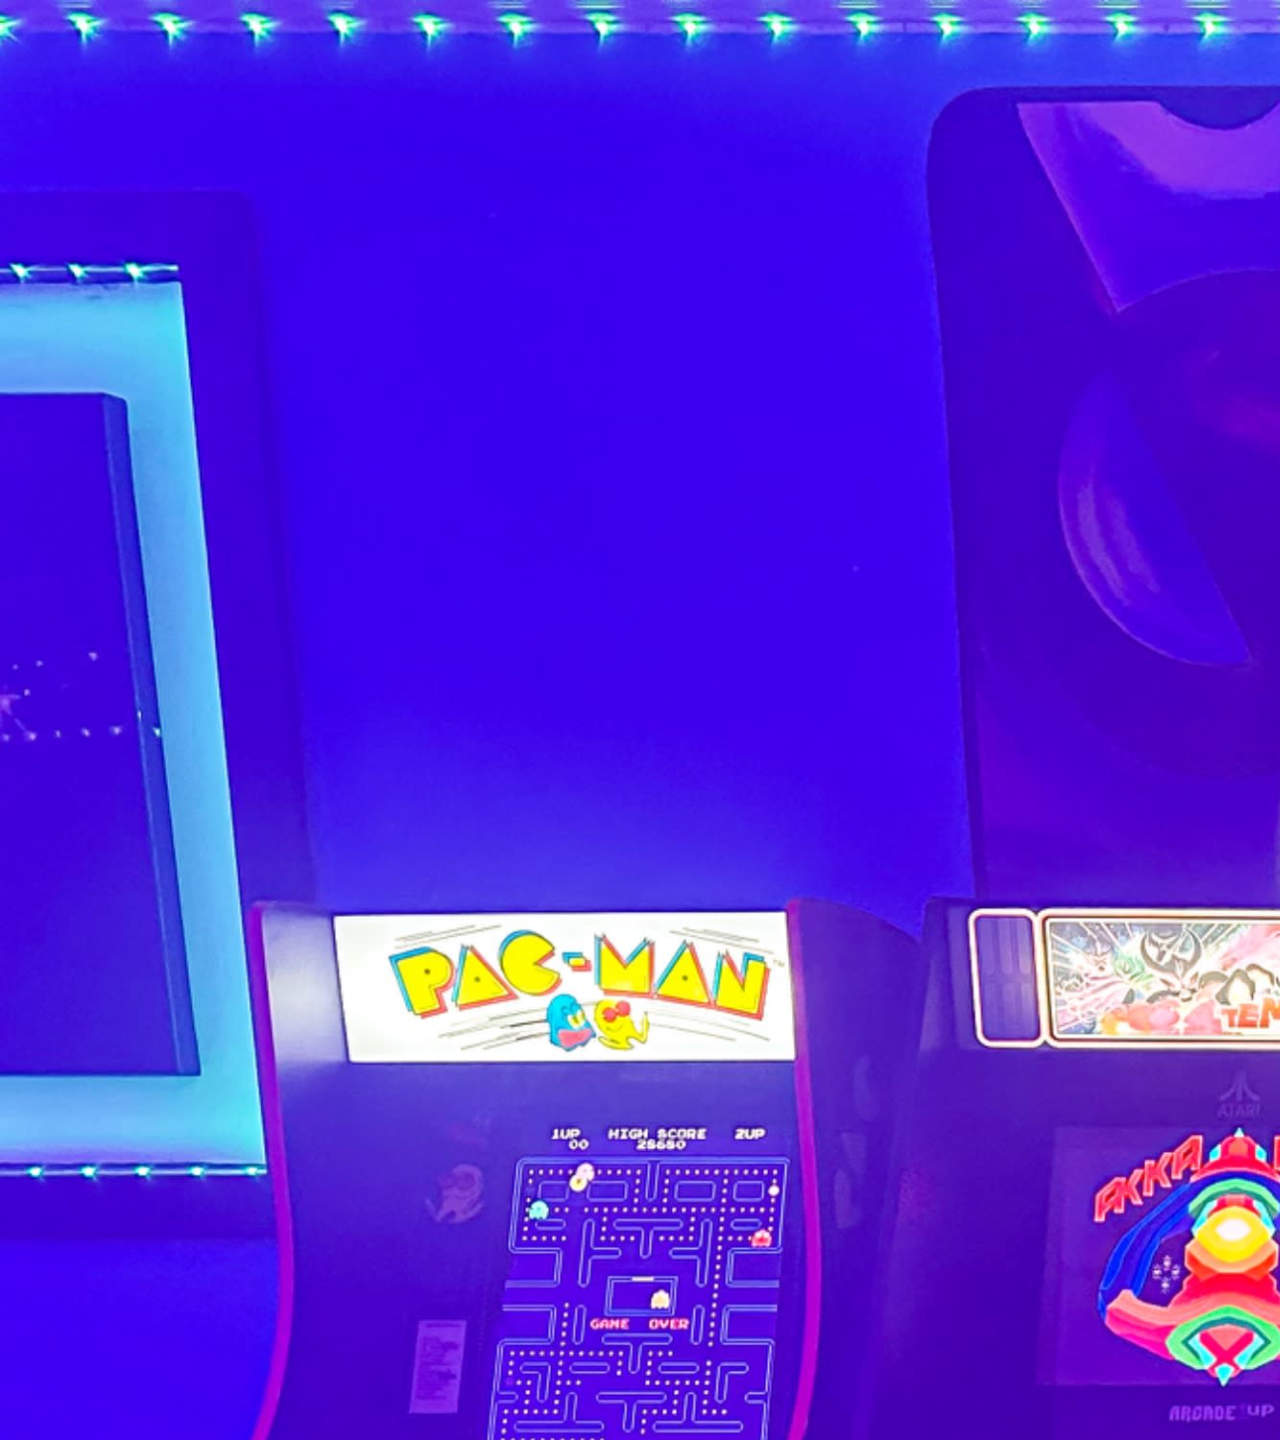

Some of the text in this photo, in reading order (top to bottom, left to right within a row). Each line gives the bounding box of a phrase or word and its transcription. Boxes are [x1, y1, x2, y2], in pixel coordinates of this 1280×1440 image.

[388, 931, 771, 1020] PAC-MAN
[552, 1128, 766, 1139] 1UP HIGH SCORE 2UP
[568, 1139, 589, 1150] 00
[590, 1318, 690, 1330] GAME OVER
